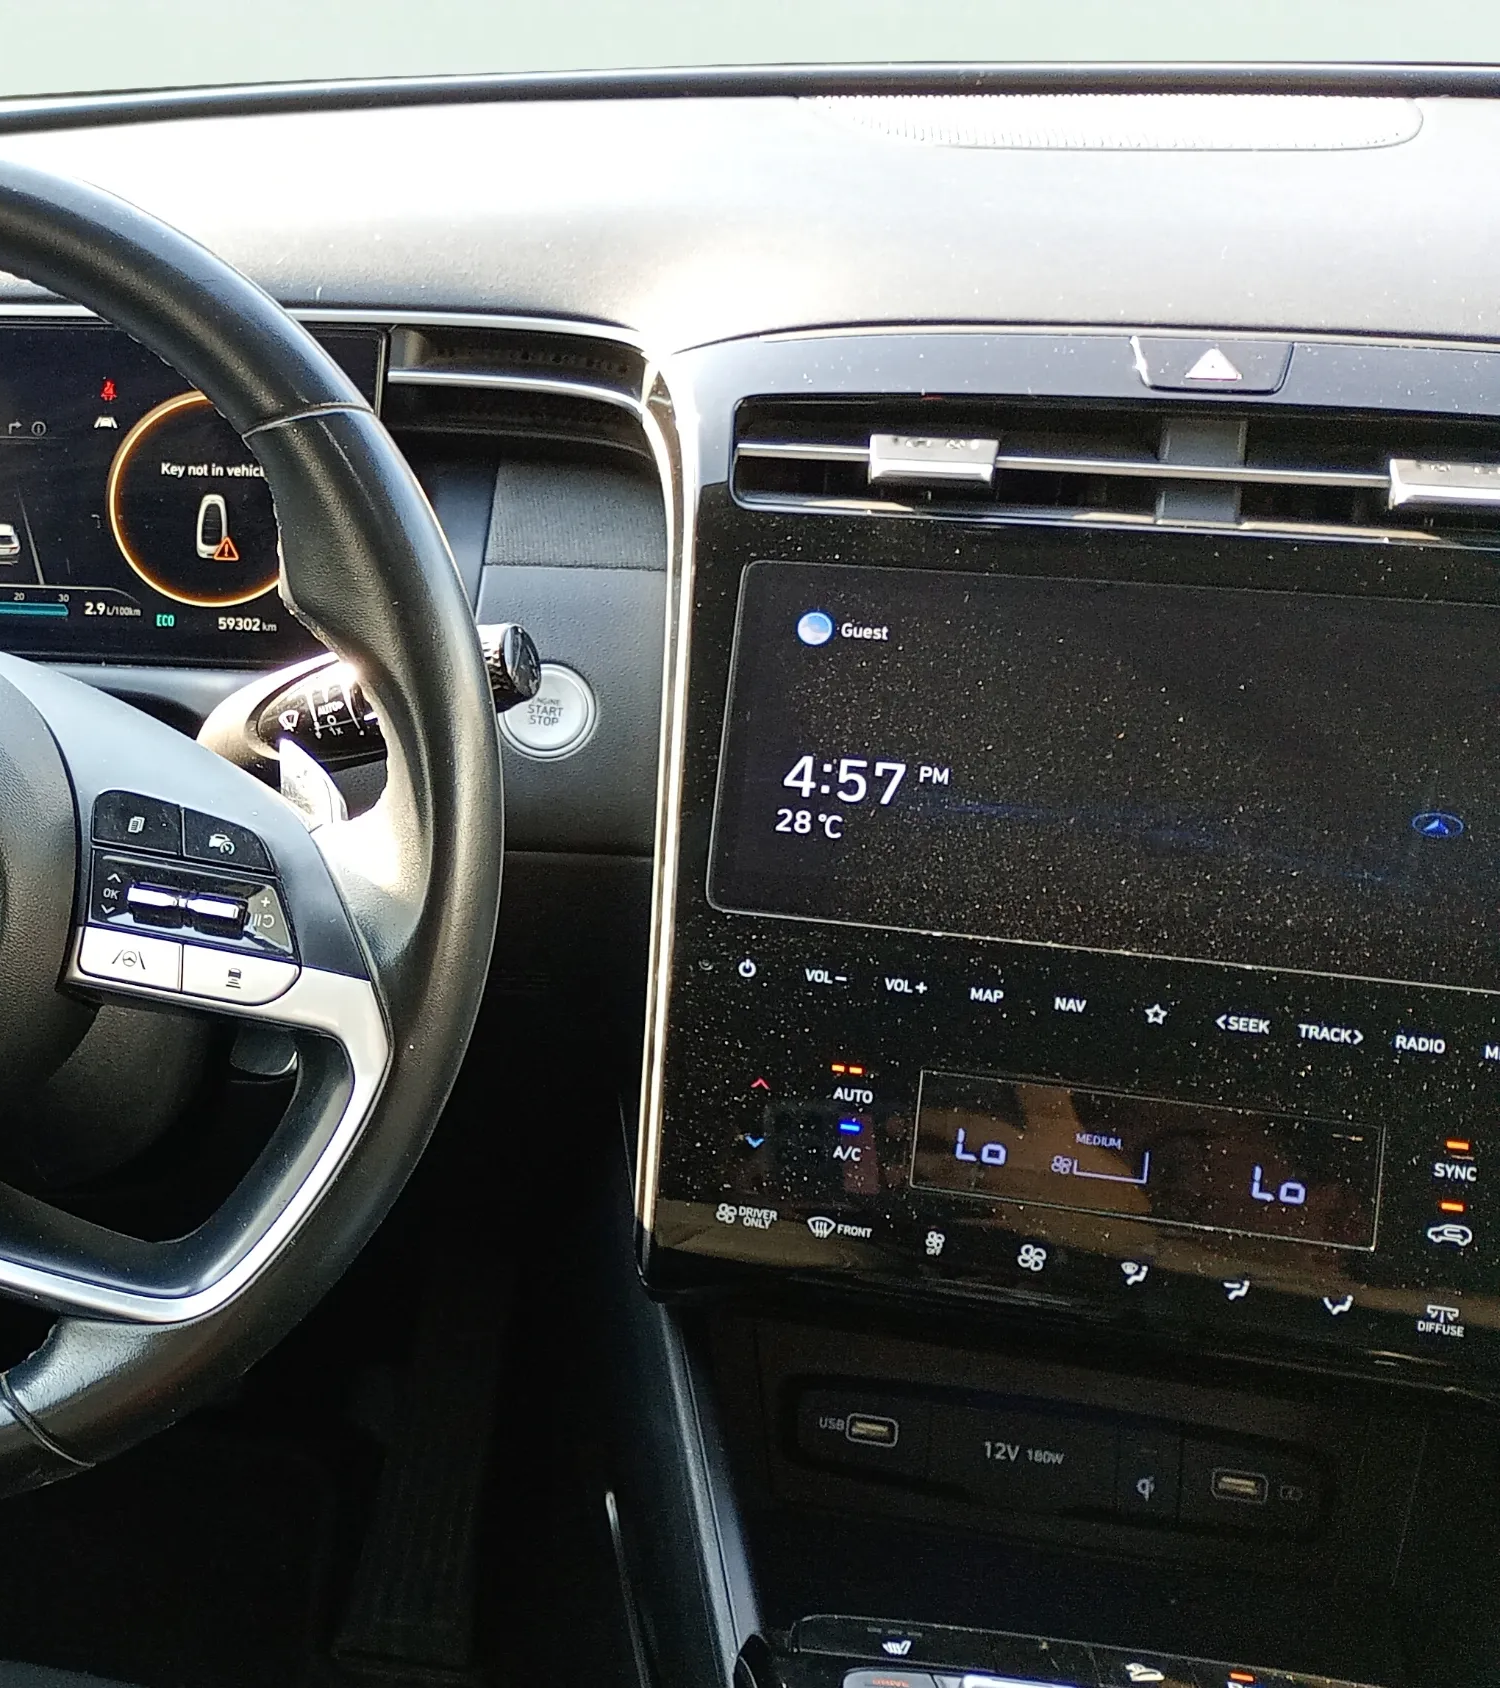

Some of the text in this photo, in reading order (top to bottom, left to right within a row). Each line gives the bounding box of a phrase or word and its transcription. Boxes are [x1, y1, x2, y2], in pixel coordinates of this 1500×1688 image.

[161, 462, 265, 478] Key not in vehicl
[13, 592, 25, 601] 20
[58, 594, 70, 603] 30
[156, 614, 175, 627] ECO
[841, 622, 889, 641] Guest
[527, 704, 564, 717] START
[529, 715, 559, 726] STOP
[783, 756, 950, 805] 4:57 PM
[103, 888, 121, 900] OK
[970, 987, 1004, 1003] MAP
[1054, 997, 1087, 1014] NAV
[1395, 1034, 1446, 1054] RADIO
[833, 1086, 873, 1104] AUTO
[1076, 1133, 1122, 1150] MEDIUM
[832, 1146, 862, 1163] A/C
[1434, 1161, 1477, 1183] SYNC
[738, 1206, 778, 1221] DRIVER
[742, 1216, 772, 1229] ONLY
[837, 1223, 873, 1238] FRONT
[1417, 1320, 1464, 1338] DIFFUSE
[819, 1416, 845, 1431] USB
[984, 1441, 1020, 1462] 12V
